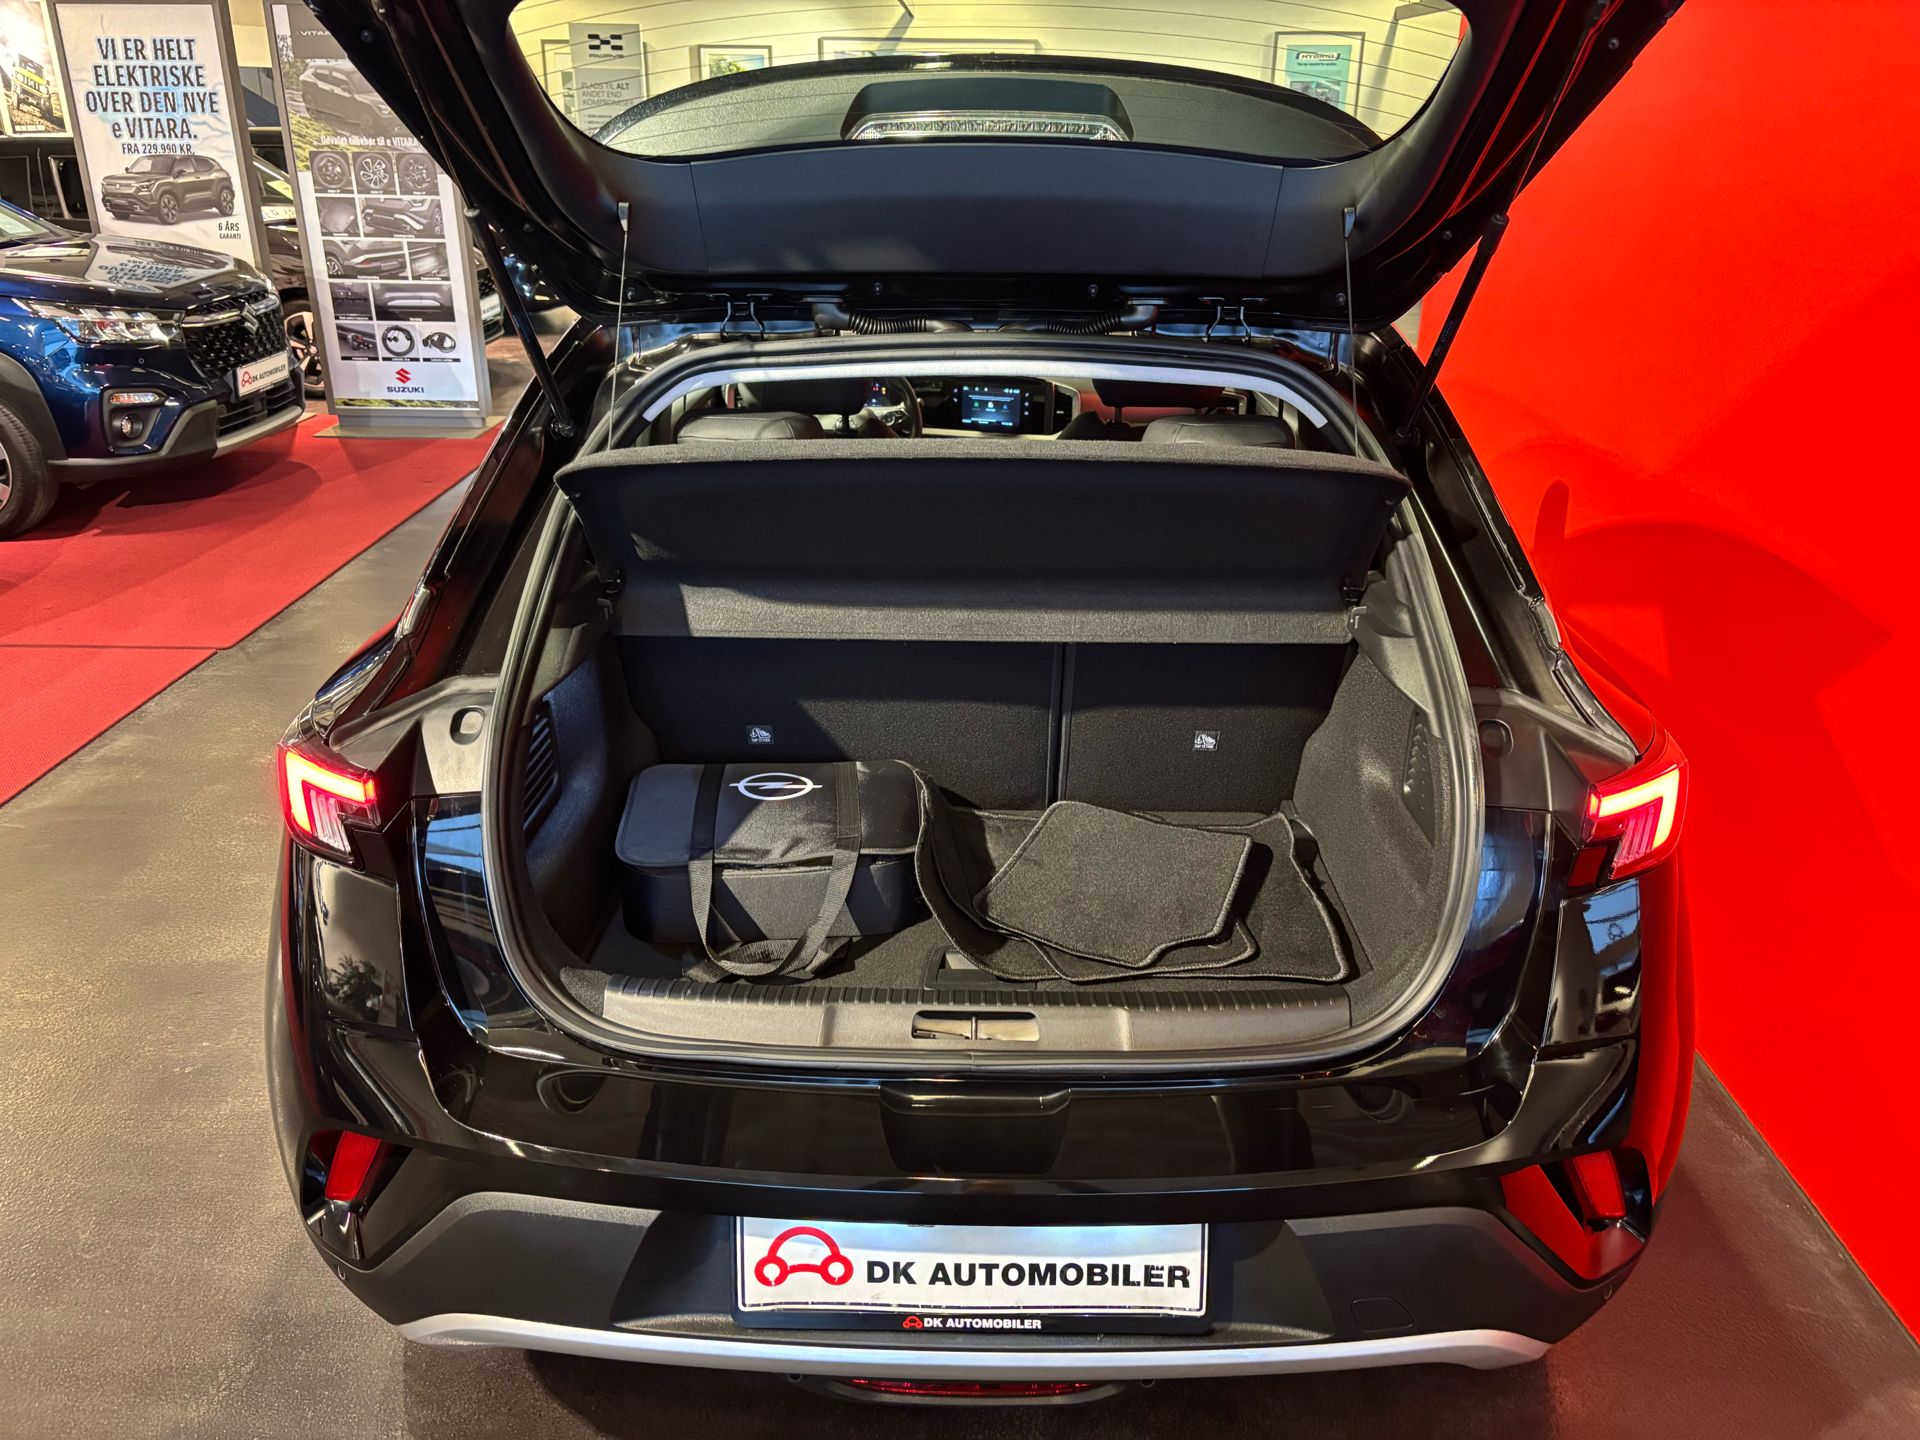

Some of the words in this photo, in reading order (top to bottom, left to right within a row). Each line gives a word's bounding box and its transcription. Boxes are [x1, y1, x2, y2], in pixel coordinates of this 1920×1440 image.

[97, 38, 118, 60] VI
[123, 38, 147, 60] ER
[153, 38, 195, 60] HELT
[93, 65, 205, 87] ELEKTRISKE
[85, 91, 134, 113] OVER
[139, 91, 177, 113] DEN
[183, 92, 219, 113] NYE
[112, 122, 122, 138] e
[125, 118, 198, 139] VITARA.
[122, 143, 140, 154] FRA
[141, 143, 177, 154] 229.990
[218, 222, 223, 231] 6
[225, 220, 240, 231] ÅRS
[867, 1260, 916, 1285] DK
[928, 1262, 1191, 1289] AUTOMOBILER
[923, 1317, 943, 1328] DK
[946, 1318, 1042, 1329] AUTOMOBILER
